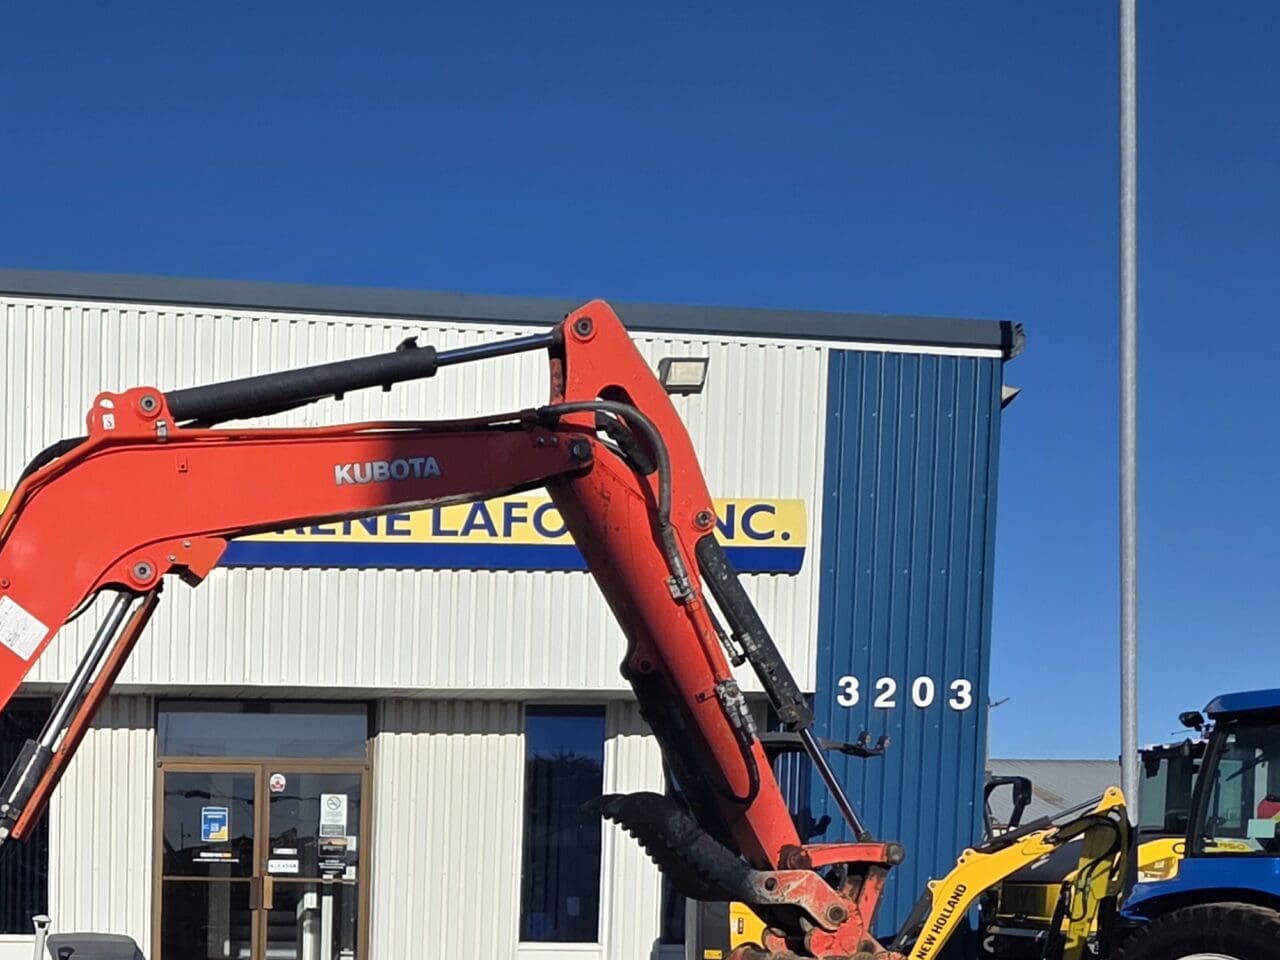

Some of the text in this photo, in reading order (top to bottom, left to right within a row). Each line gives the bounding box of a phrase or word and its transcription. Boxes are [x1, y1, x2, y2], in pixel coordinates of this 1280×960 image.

[333, 456, 441, 486] KUBOTA
[431, 500, 570, 539] LAFO
[716, 503, 791, 541] NC.
[836, 675, 973, 711] 3203
[915, 883, 968, 960] NEW HOLLAND
